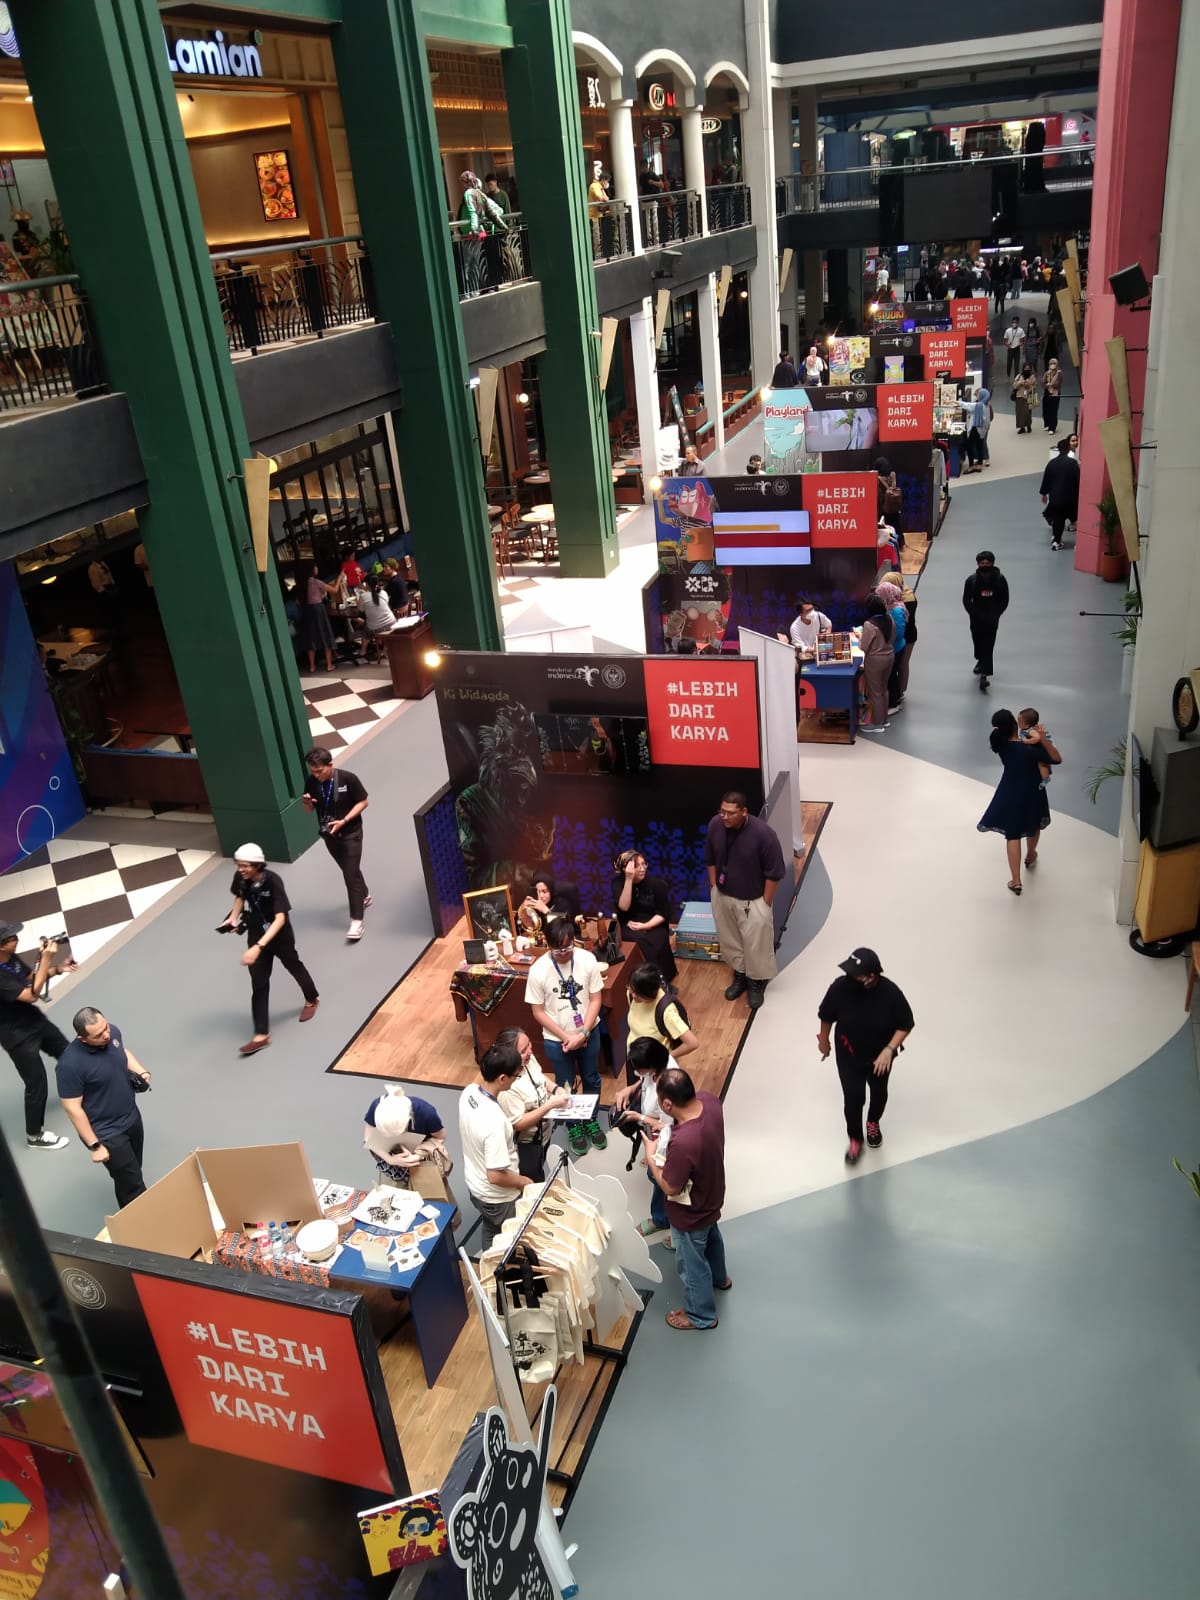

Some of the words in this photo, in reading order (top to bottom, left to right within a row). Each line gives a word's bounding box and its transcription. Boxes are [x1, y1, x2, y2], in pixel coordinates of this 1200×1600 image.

[929, 340, 959, 348] #LEBIH
[929, 350, 949, 358] DARI
[887, 394, 925, 404] #LEBIH
[765, 405, 809, 419] Playland
[887, 407, 912, 416] DARI
[887, 418, 918, 428] KARYA
[816, 487, 866, 499] #LEBIH
[817, 503, 849, 514] DARI
[817, 518, 857, 530] KARYA
[666, 680, 738, 697] #LEBIH
[668, 703, 715, 719] DARI
[670, 725, 729, 741] KARYA
[186, 1320, 328, 1371] #LEBIH
[197, 1354, 290, 1397] DARI
[209, 1391, 326, 1440] KARYA
